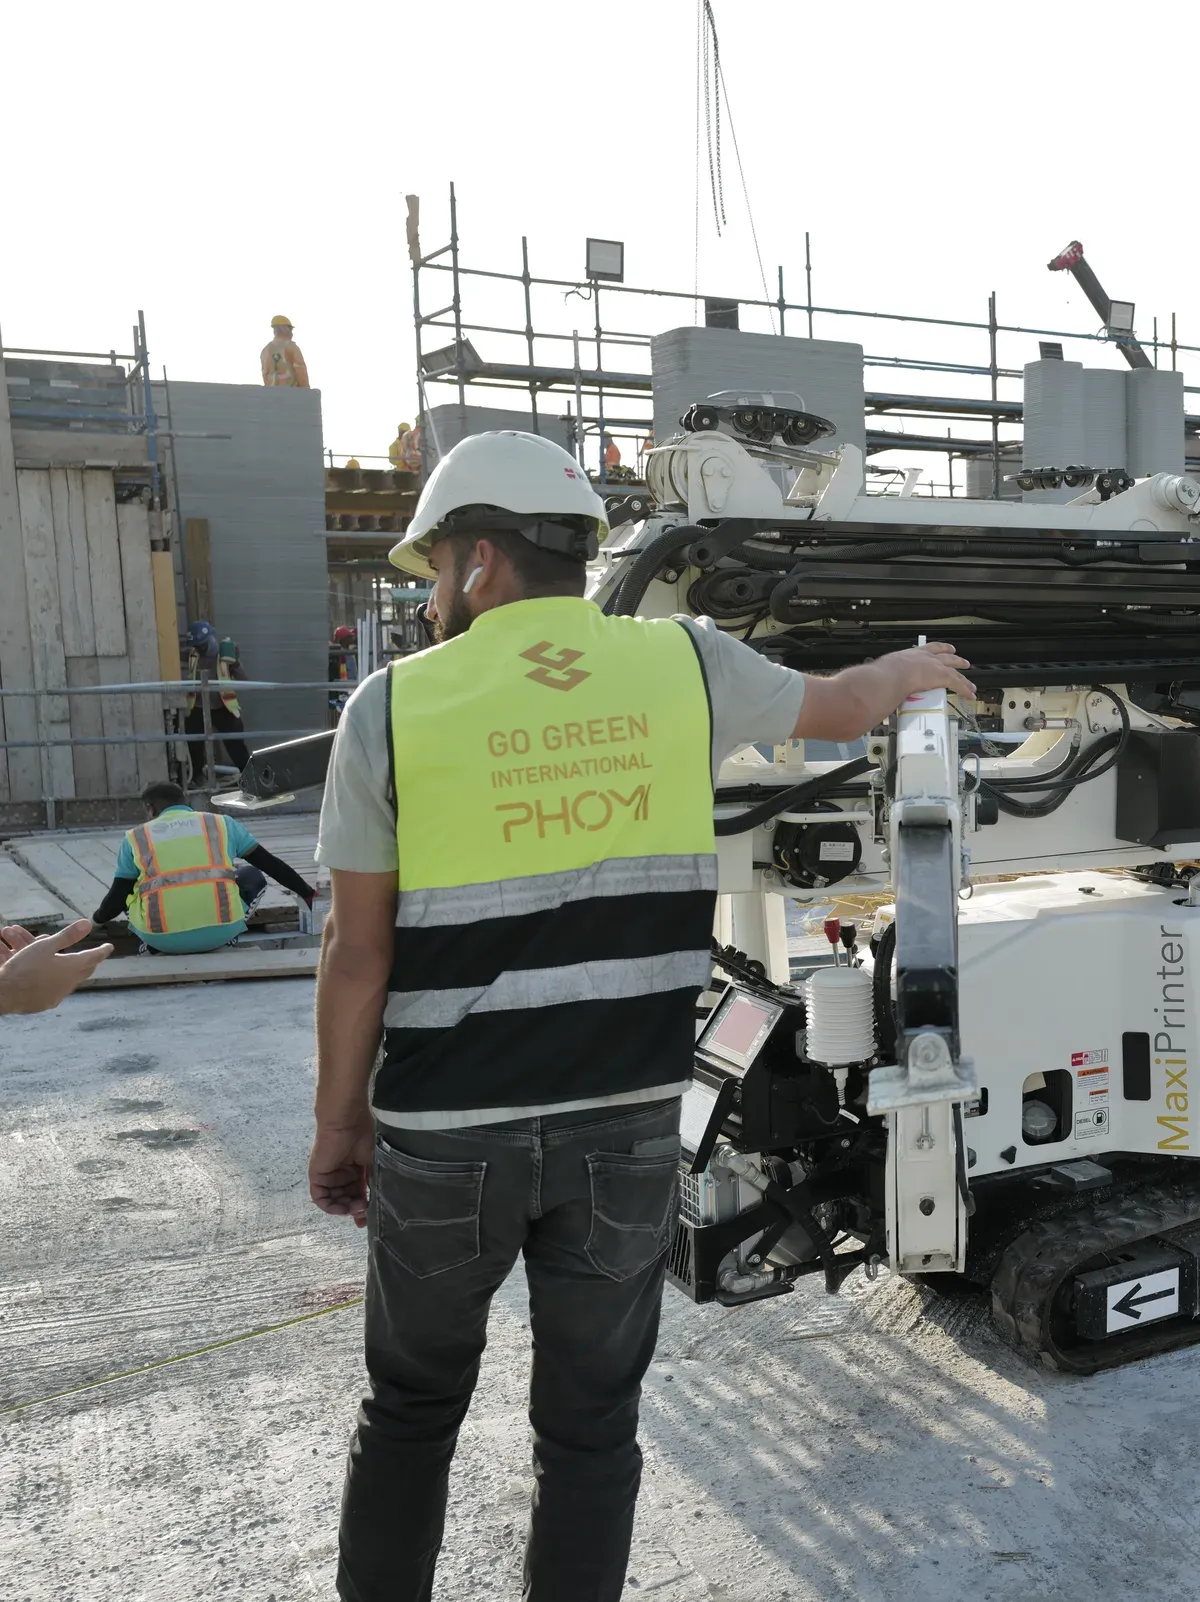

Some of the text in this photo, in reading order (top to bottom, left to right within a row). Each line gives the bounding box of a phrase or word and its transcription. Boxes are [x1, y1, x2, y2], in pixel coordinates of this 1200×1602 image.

[487, 713, 649, 757] GO GREEN
[491, 752, 653, 788] INTERNATIONAL
[1154, 925, 1189, 1150] MaxiPrinter
